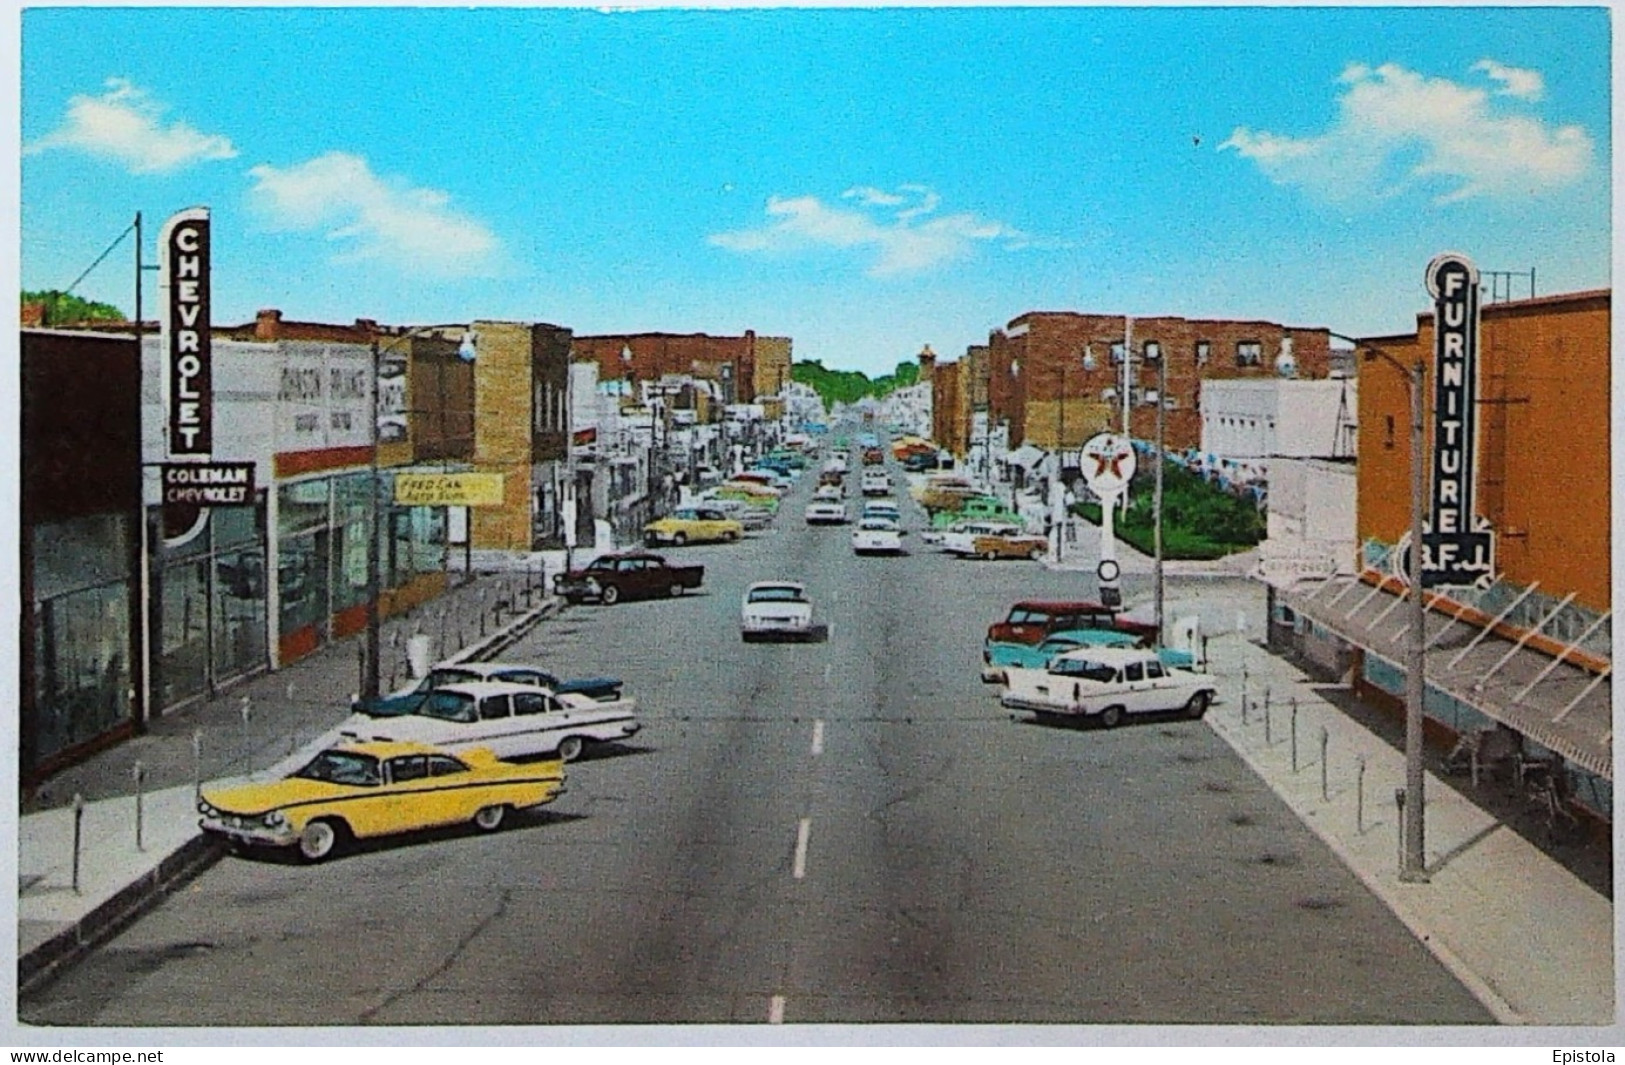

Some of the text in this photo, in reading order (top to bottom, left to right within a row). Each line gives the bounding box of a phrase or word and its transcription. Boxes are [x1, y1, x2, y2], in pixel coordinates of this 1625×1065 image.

[176, 227, 200, 449] CHEVROLET
[1439, 272, 1464, 534] FURNITURE
[167, 468, 248, 483] COLEMAN
[167, 487, 246, 502] CHEVROLET
